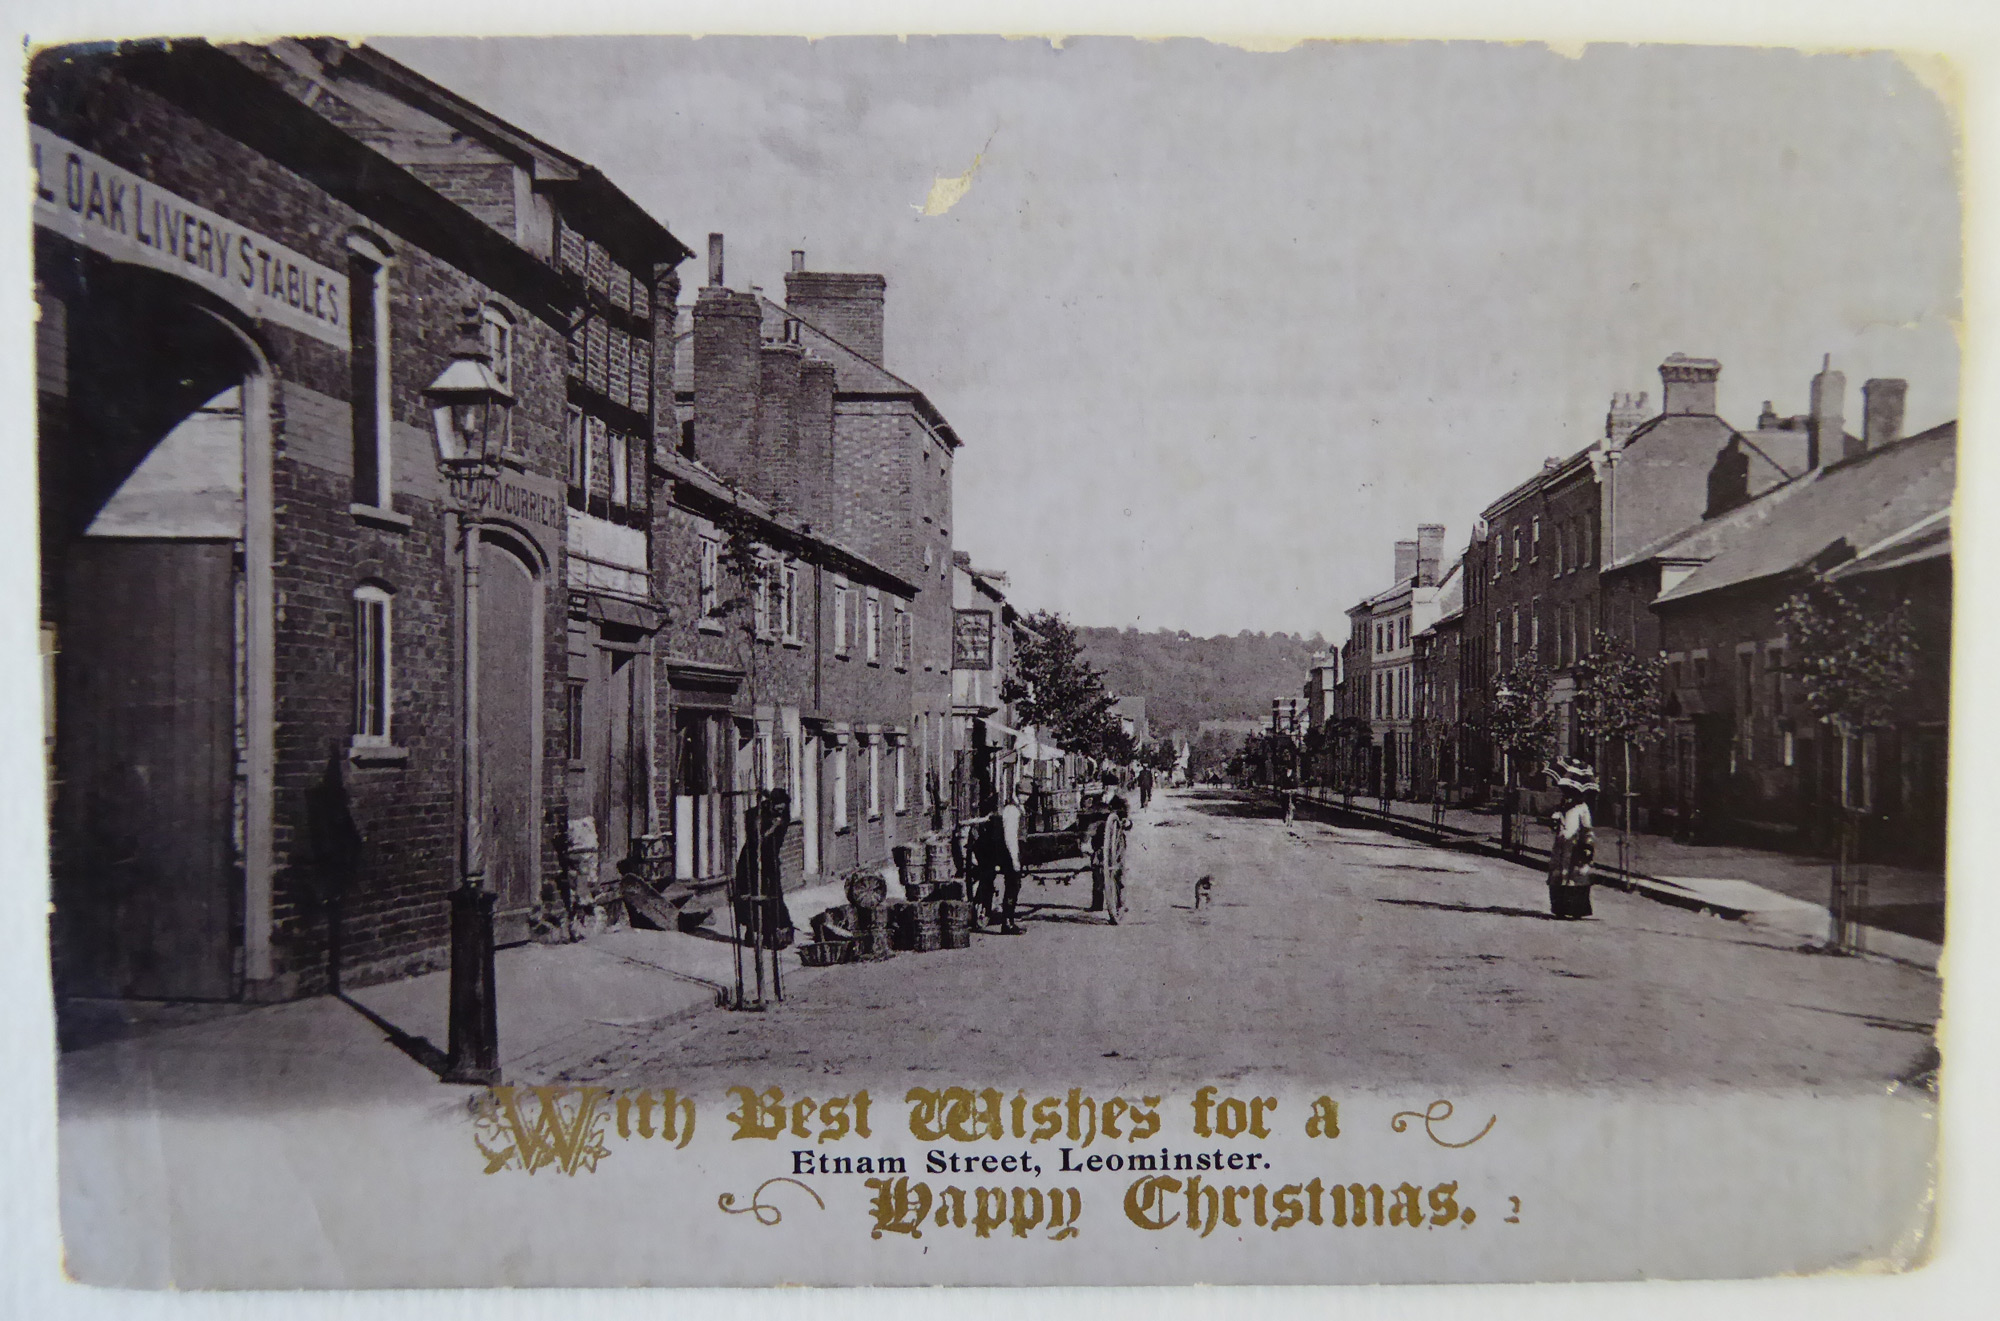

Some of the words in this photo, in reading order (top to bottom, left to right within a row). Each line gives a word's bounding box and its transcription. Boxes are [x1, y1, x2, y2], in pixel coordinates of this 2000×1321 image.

[66, 152, 127, 235] OAK
[135, 184, 231, 278] LIVERY
[239, 235, 338, 325] STABLES
